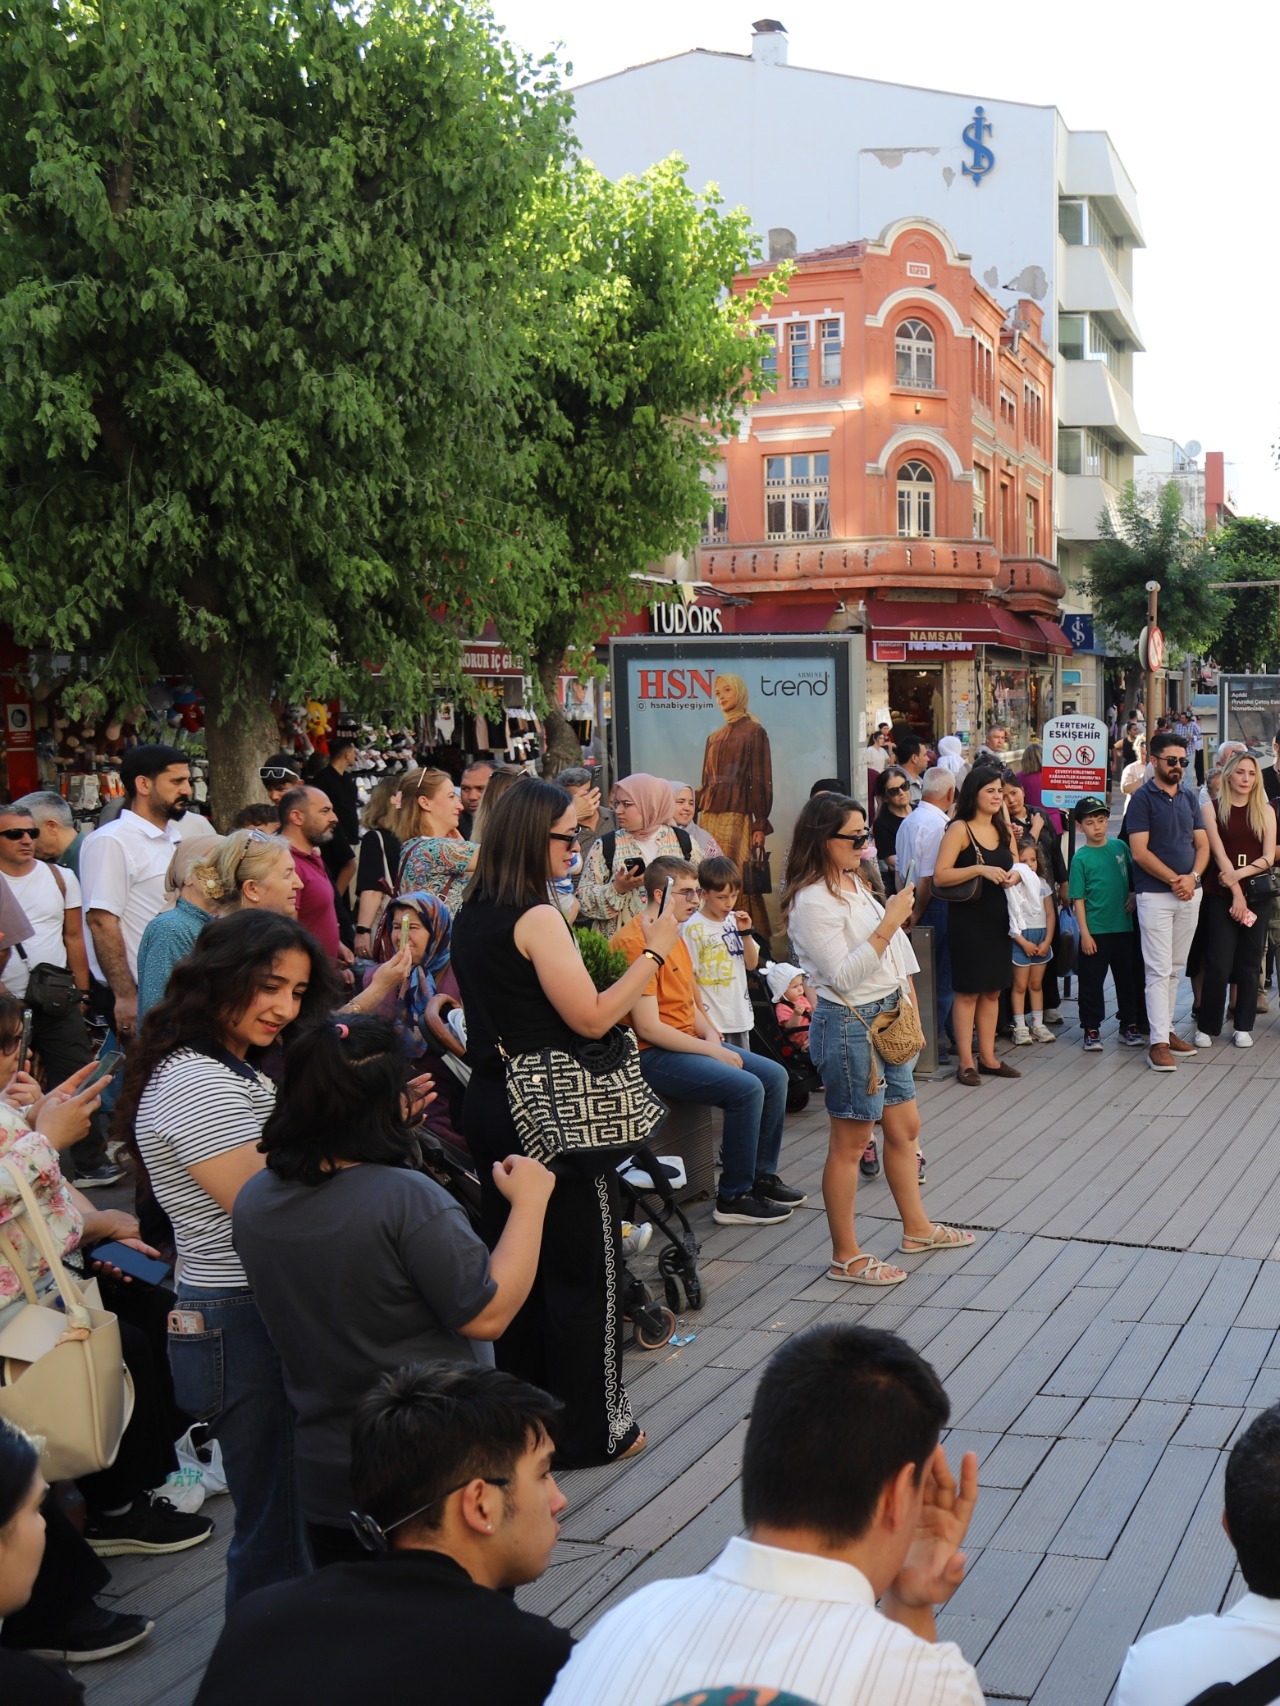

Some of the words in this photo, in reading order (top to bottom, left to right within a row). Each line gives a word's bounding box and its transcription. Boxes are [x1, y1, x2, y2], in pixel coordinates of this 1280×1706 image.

[653, 601, 723, 633] TUDORS
[910, 631, 963, 641] NAMSAN
[491, 650, 500, 672] İÇ
[636, 669, 715, 700] HSN
[761, 671, 829, 697] trend
[650, 701, 714, 710] hsnabiyegiyim
[1049, 730, 1101, 741] ESKİŞEHİR
